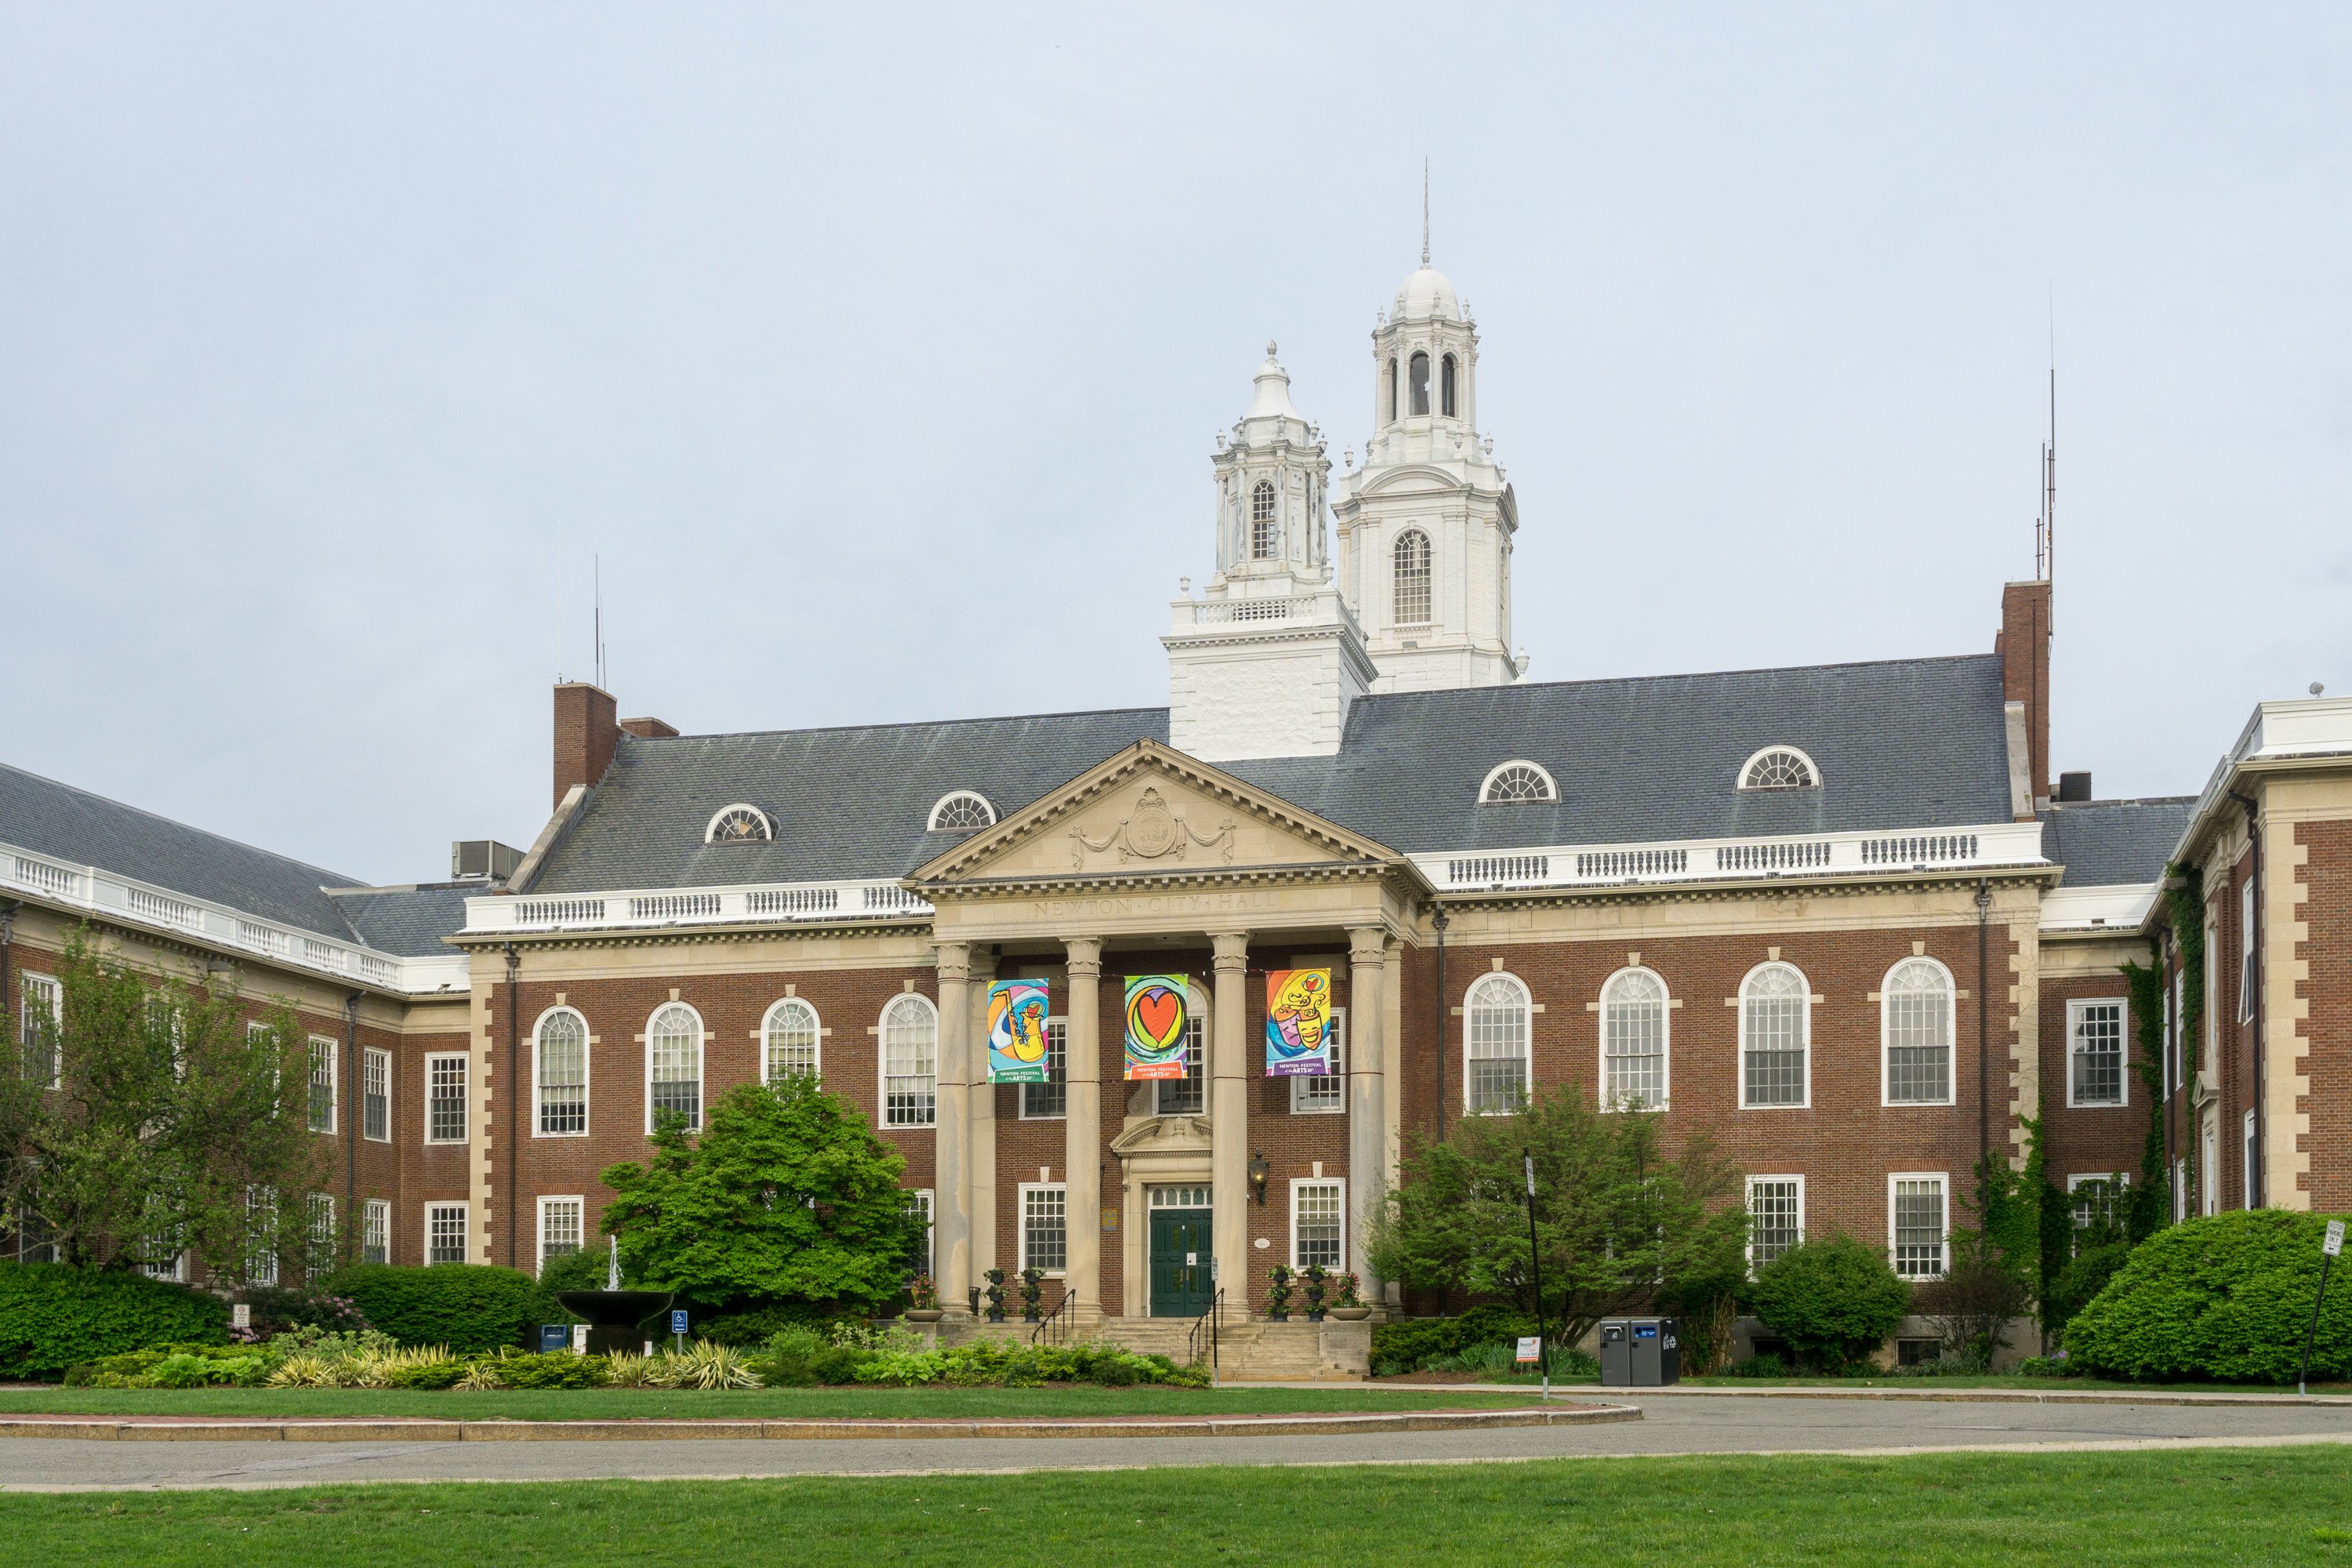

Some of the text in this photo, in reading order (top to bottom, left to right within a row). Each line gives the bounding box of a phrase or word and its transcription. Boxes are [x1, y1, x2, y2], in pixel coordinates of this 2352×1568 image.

[1035, 893, 1276, 916] NEWTON CITY HALL
